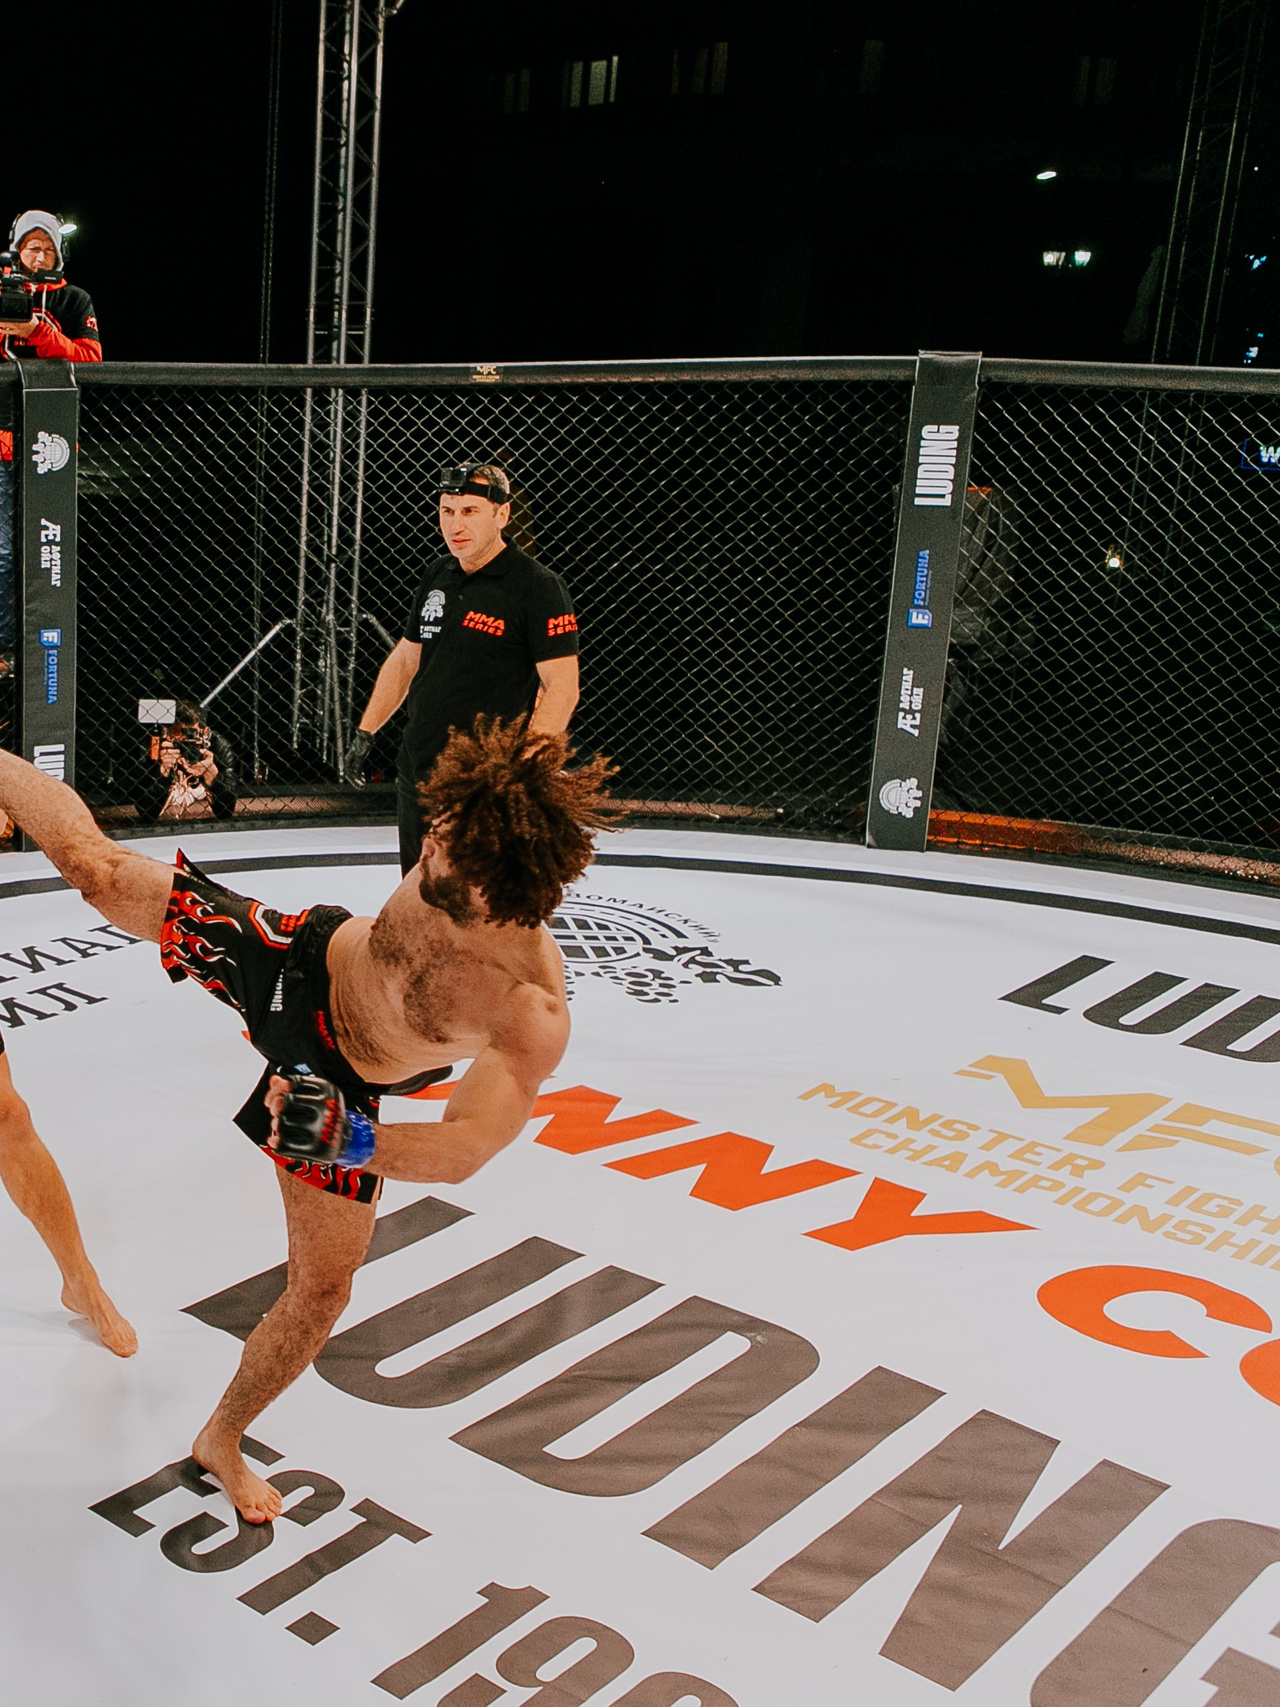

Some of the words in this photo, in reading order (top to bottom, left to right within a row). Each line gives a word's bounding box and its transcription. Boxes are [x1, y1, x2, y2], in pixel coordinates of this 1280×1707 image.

[914, 425, 960, 507] LUDING
[913, 550, 930, 606] FORTUNA
[462, 619, 504, 637] SERIES
[465, 610, 506, 630] MMA
[46, 650, 59, 705] FORTUNA
[797, 1082, 1106, 1179] MONSTER
[179, 1195, 1280, 1707] LUDING
[88, 1434, 433, 1645] EST.
